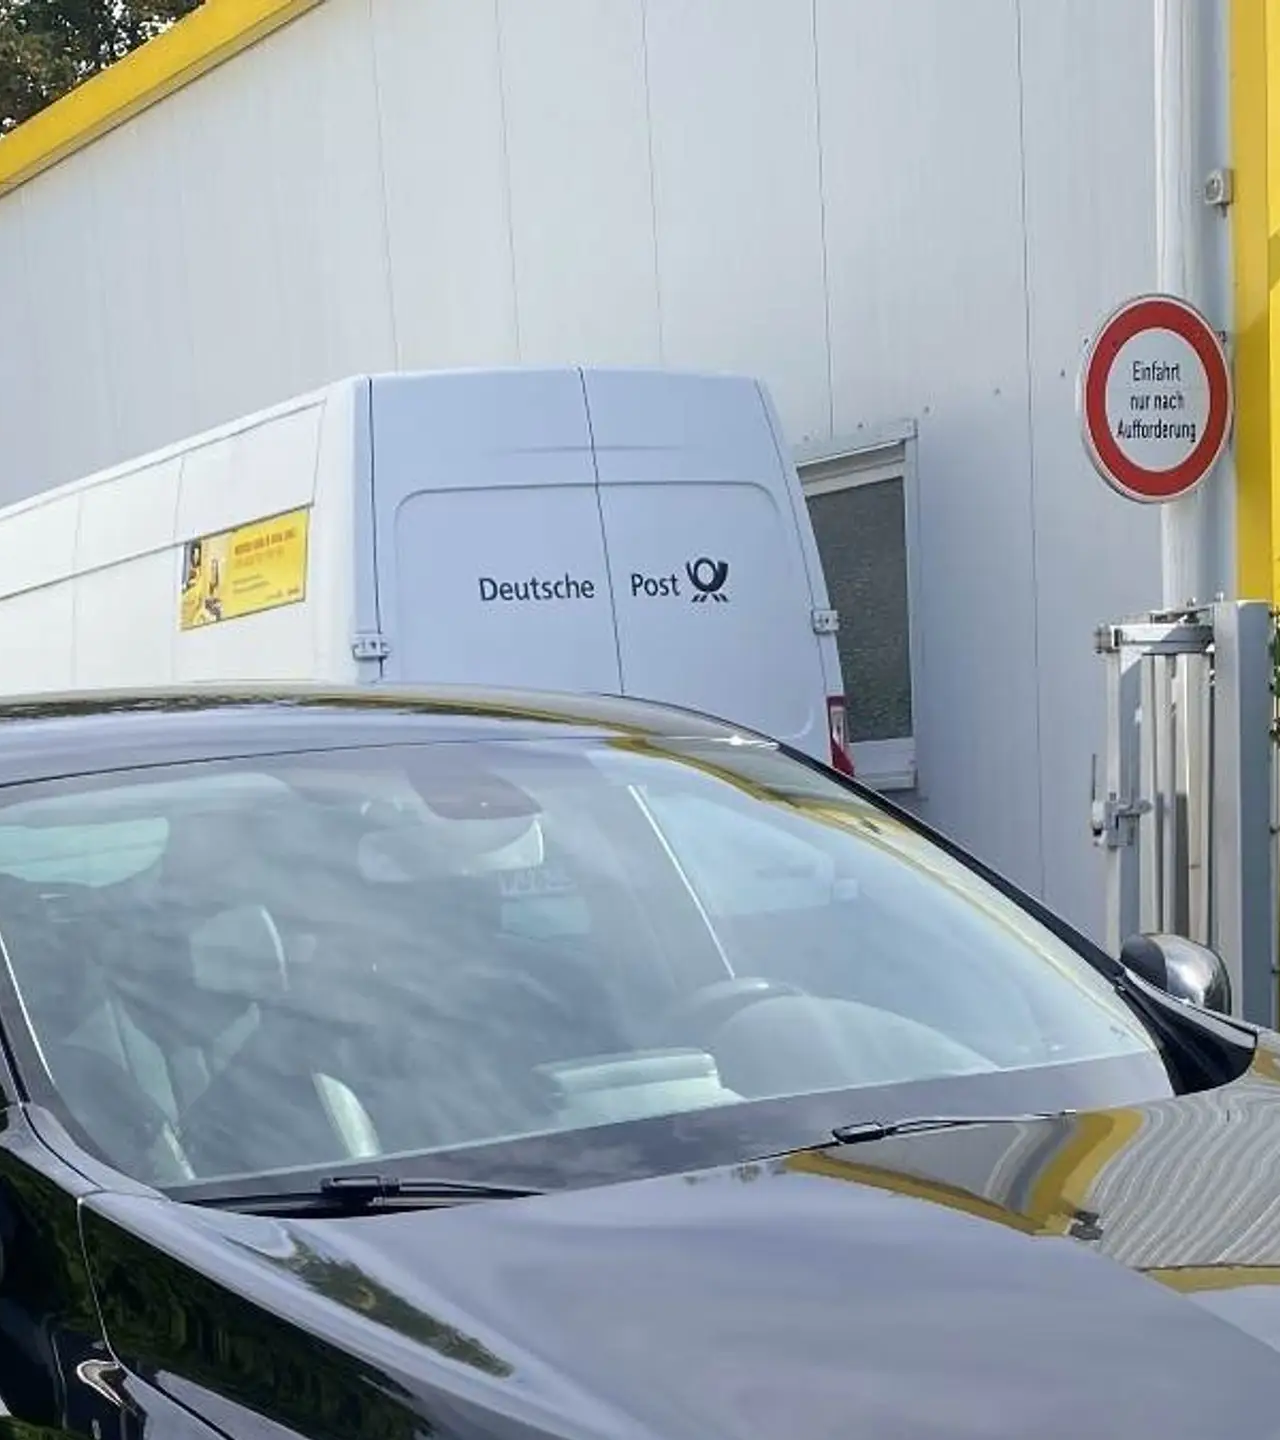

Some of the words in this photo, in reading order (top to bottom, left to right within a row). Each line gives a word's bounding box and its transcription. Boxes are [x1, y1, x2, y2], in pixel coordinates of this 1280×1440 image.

[1132, 360, 1181, 382] Einfahrt
[1129, 394, 1151, 411] nur
[1153, 391, 1185, 411] nach
[1116, 418, 1197, 443] Aufforderung
[479, 572, 595, 601] Deutsche
[631, 573, 681, 597] Post
